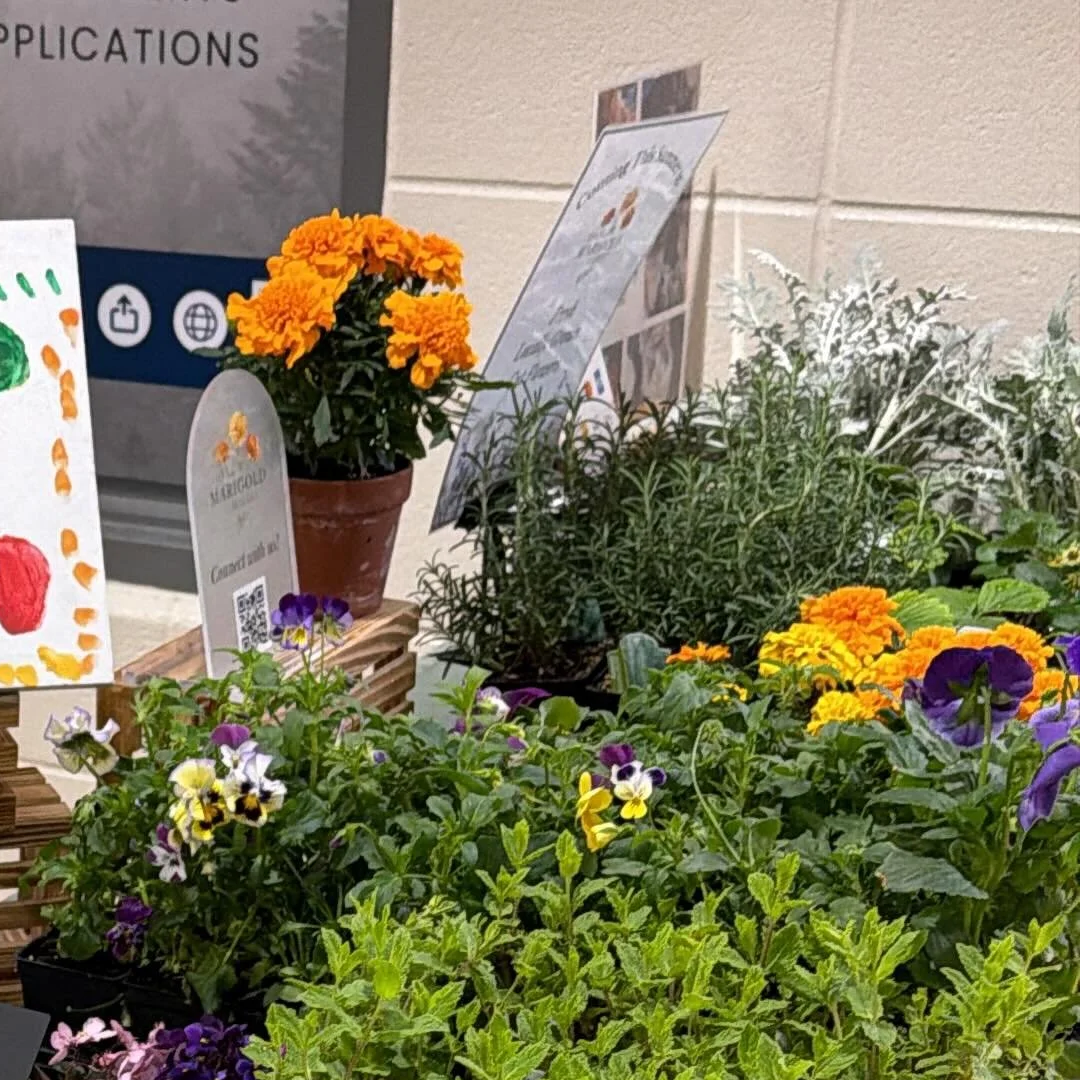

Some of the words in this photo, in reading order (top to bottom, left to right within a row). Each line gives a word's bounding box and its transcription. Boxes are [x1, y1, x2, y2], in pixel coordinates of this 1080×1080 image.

[209, 467, 267, 507] MARIGOLD
[210, 551, 246, 585] Connect
[246, 541, 266, 567] with
